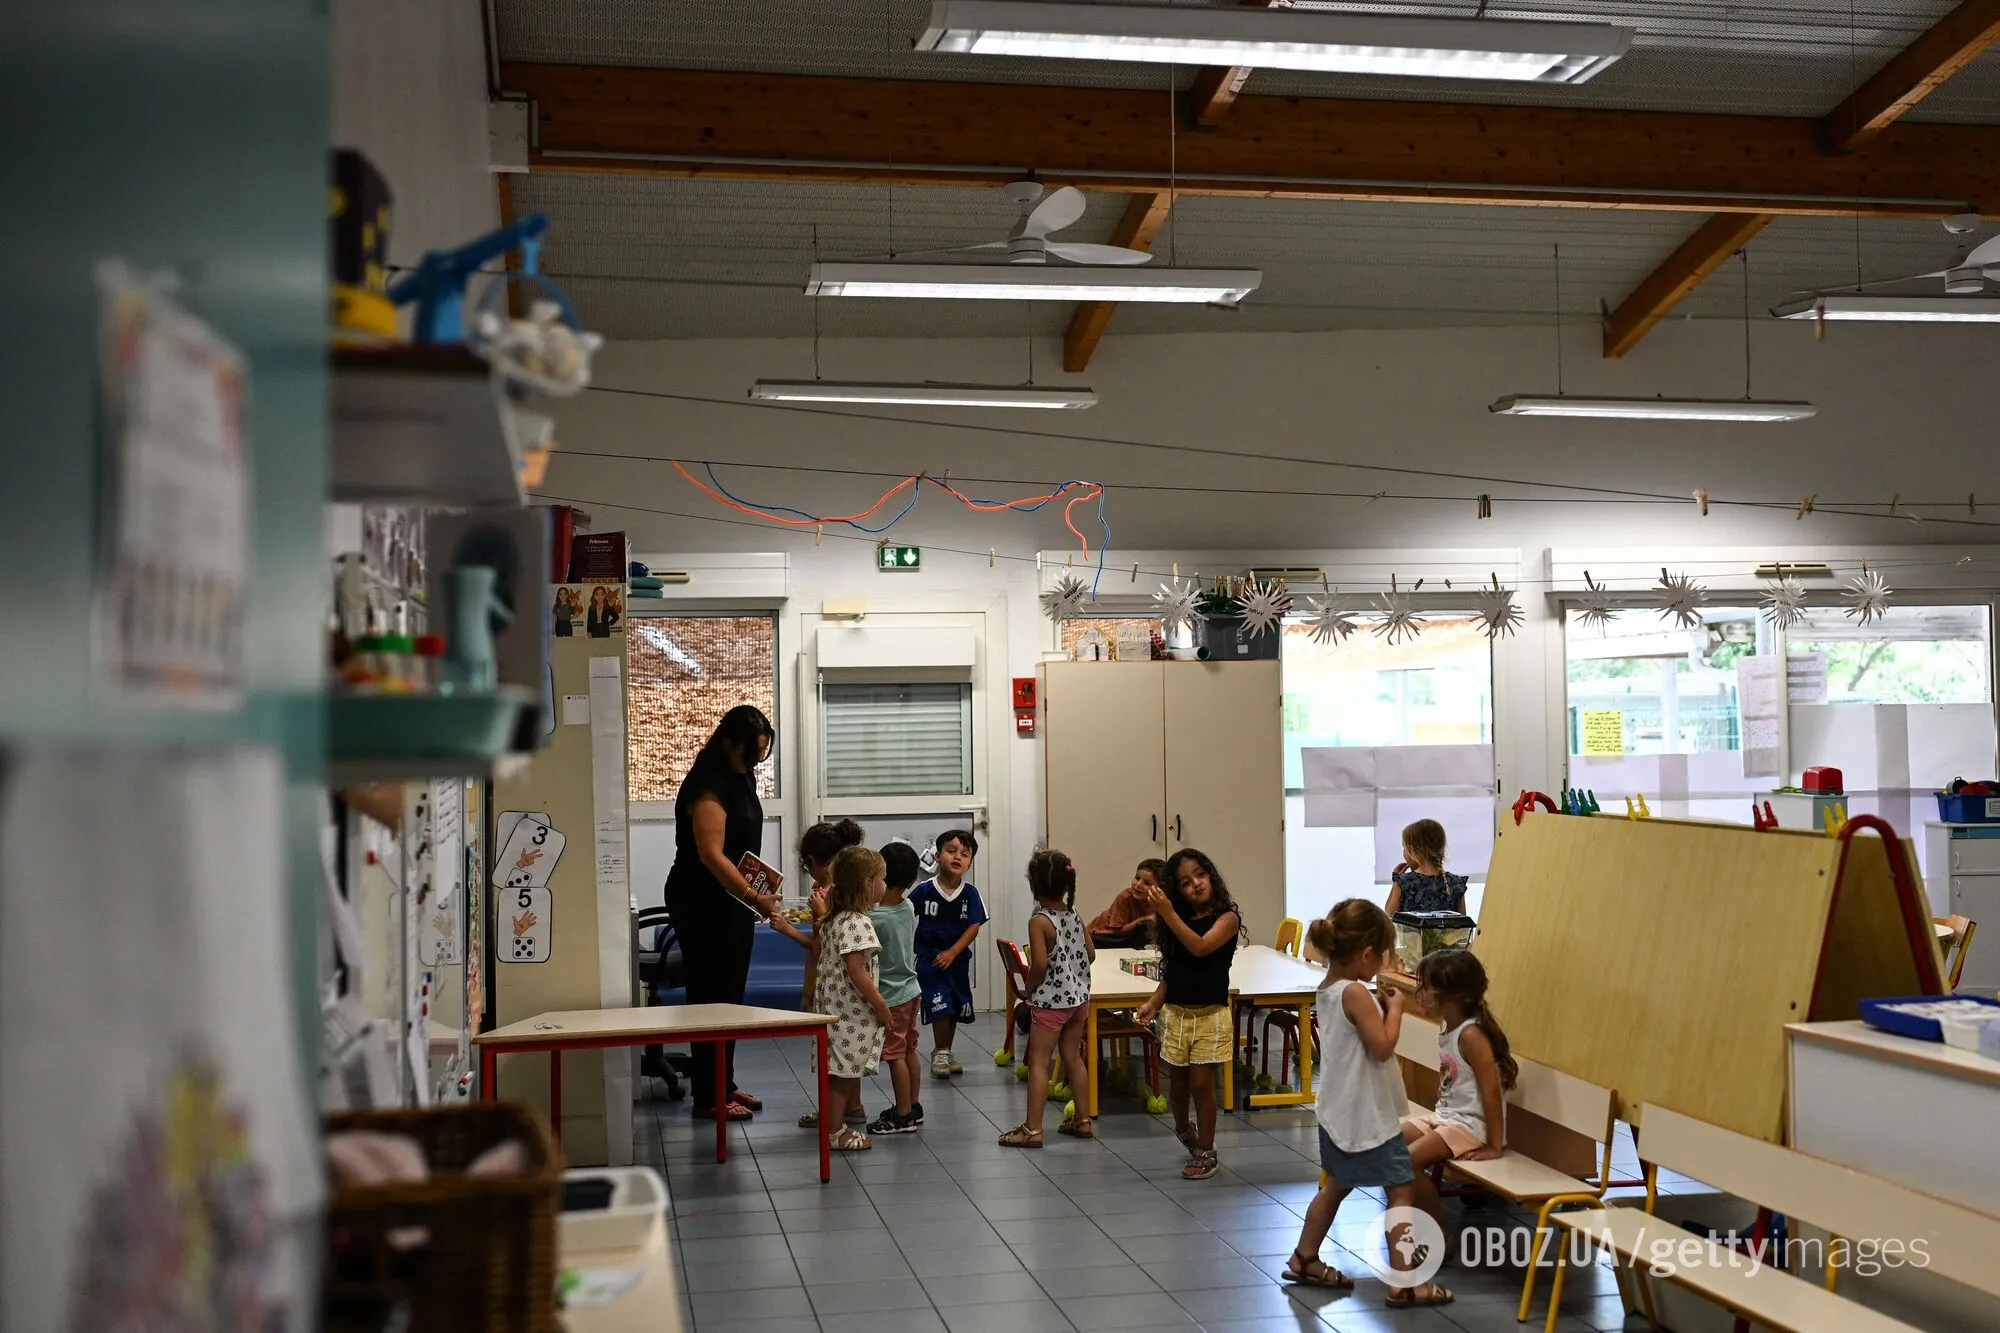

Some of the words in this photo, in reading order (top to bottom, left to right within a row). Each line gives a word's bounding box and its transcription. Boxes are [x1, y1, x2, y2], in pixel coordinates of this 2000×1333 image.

[532, 826, 548, 846] 3
[518, 888, 532, 908] 5
[925, 900, 939, 917] 10
